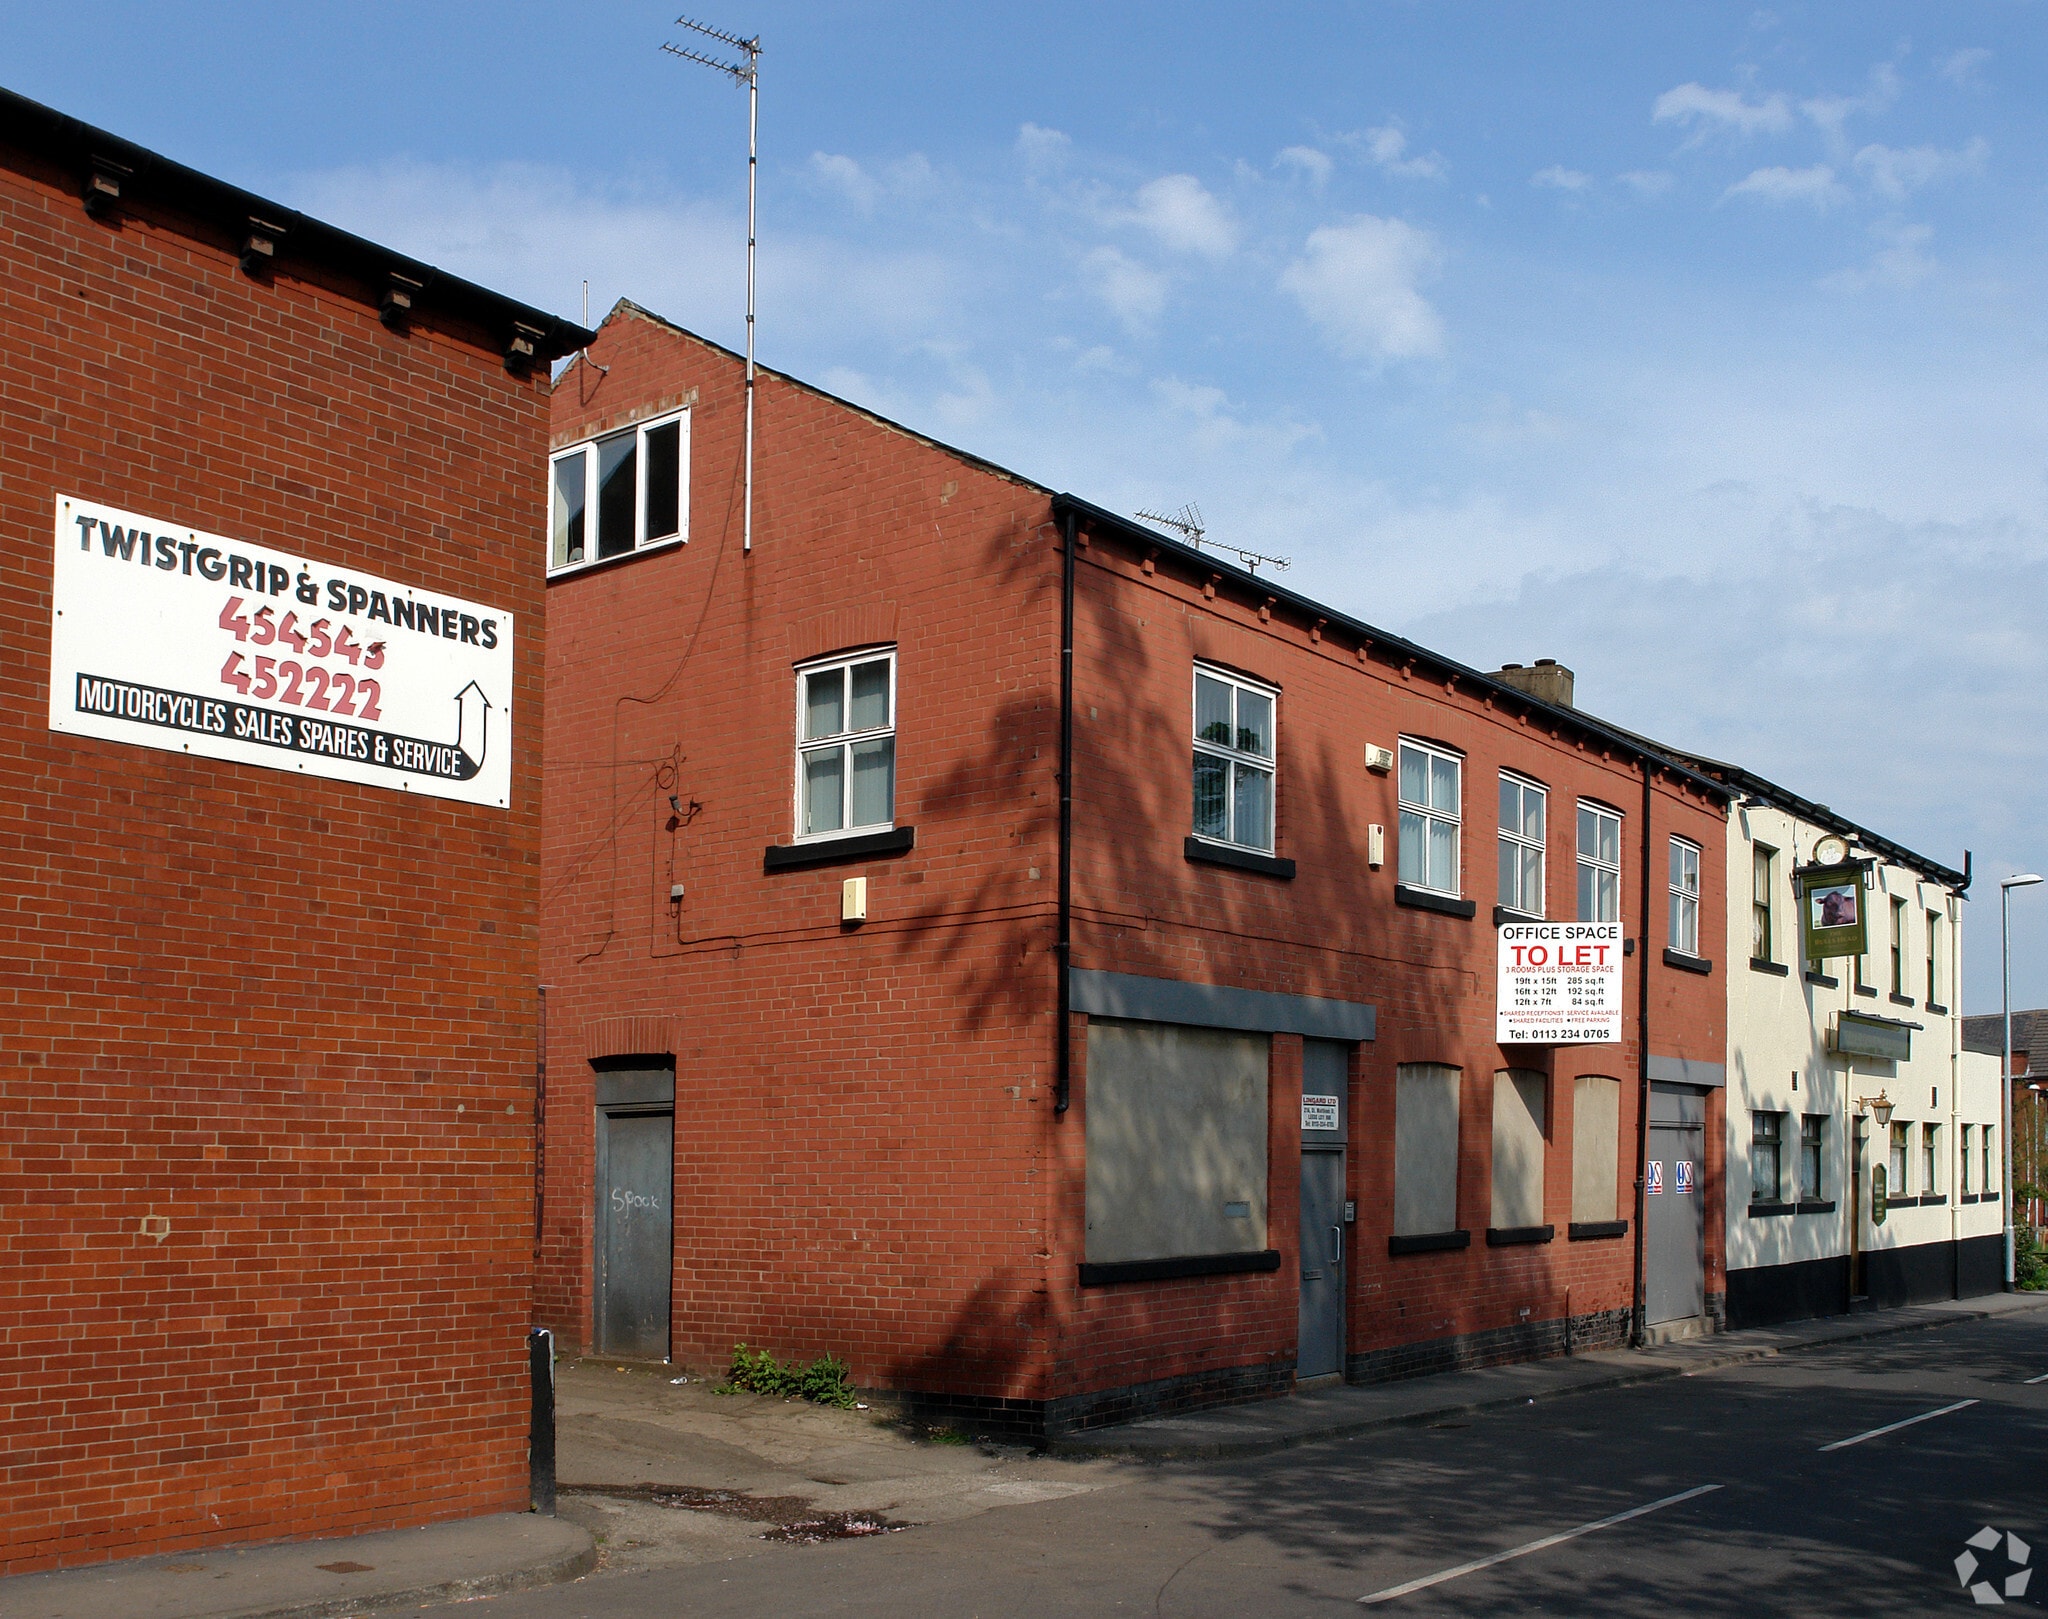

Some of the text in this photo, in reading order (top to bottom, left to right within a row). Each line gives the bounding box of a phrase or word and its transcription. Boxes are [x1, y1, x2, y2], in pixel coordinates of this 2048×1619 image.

[75, 515, 498, 650] TWISTGRIP & SPANNERS
[221, 650, 382, 721] 452222
[80, 677, 462, 777] MOTORCYCLES SALES SPARES & SERVICE
[1503, 926, 1618, 940] OFFICE SPACE
[1511, 945, 1610, 966] TO LET
[1515, 977, 1530, 985] 19ft
[1542, 977, 1557, 985] 15ft
[1567, 977, 1583, 985] 285
[1585, 977, 1604, 986] sq.ft
[1585, 987, 1604, 997] sq.ft
[1515, 998, 1530, 1006] 12ft
[1585, 998, 1604, 1007] sq.ft
[1509, 1029, 1610, 1039] Tel: 0113 234 0705
